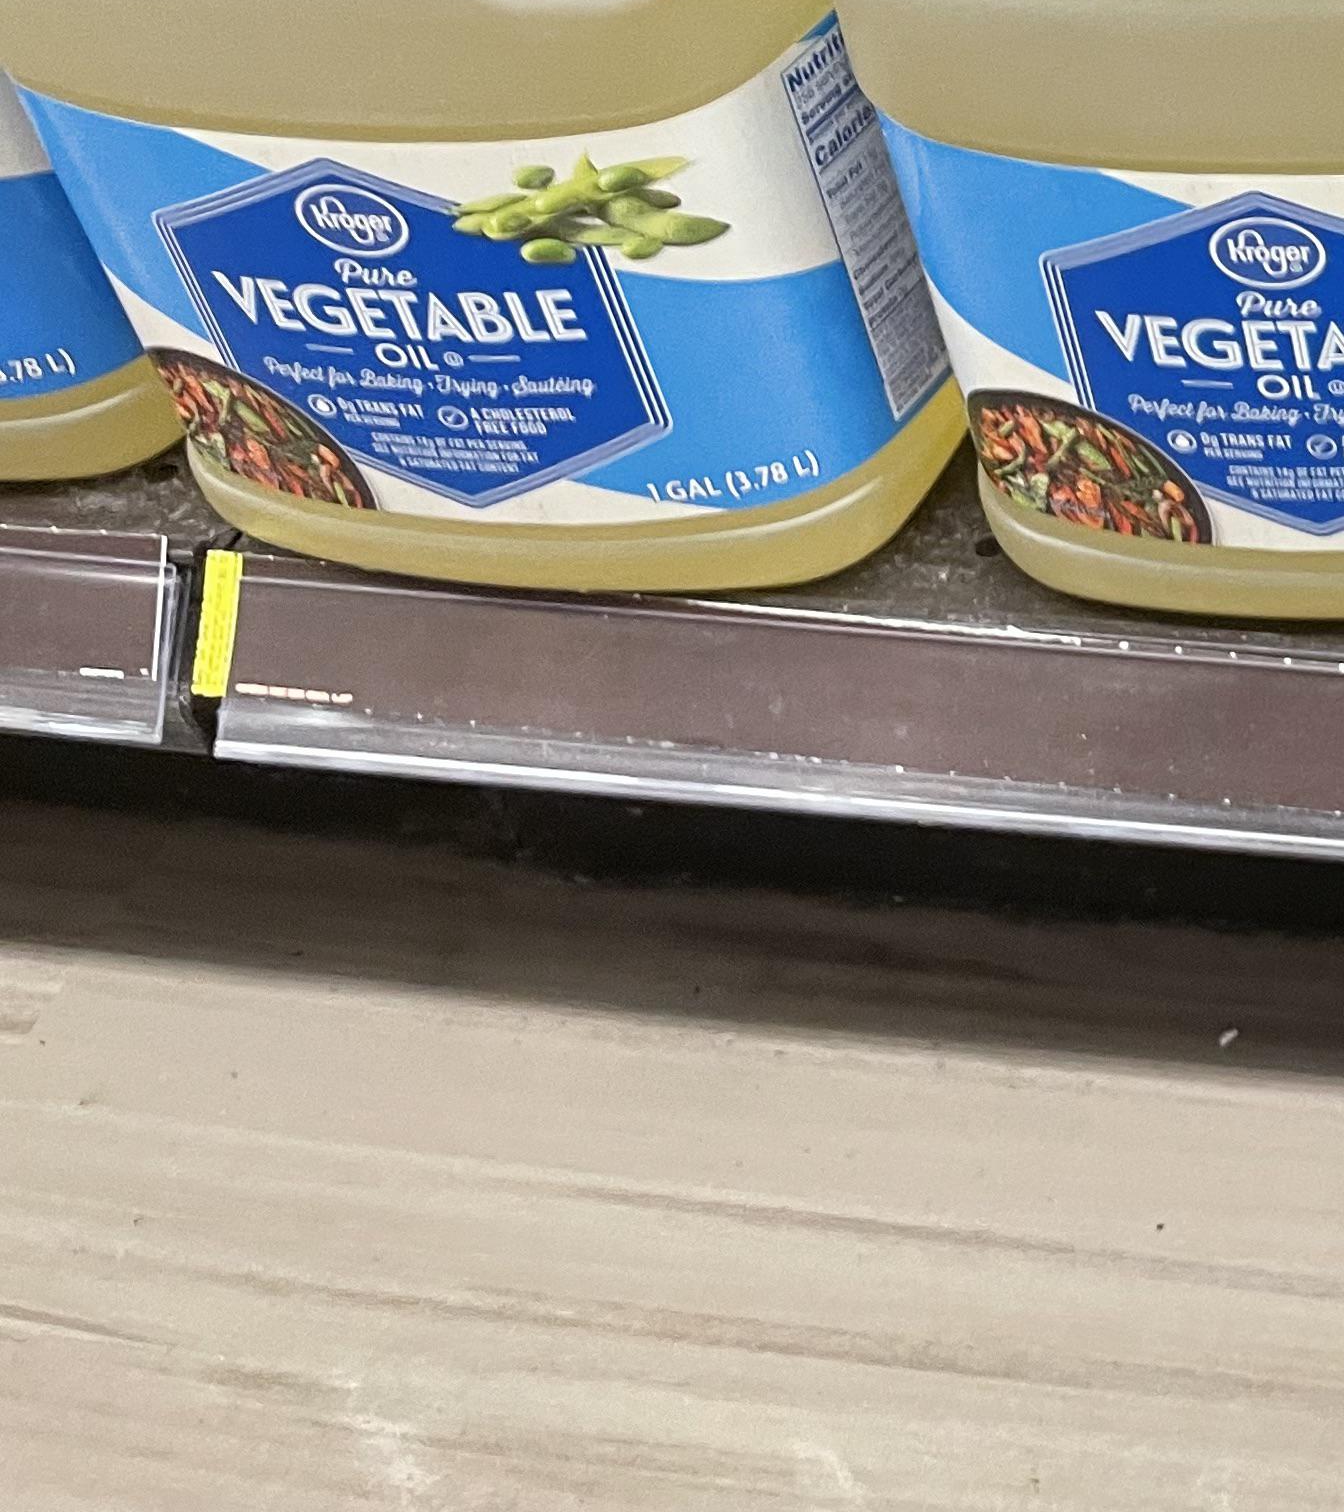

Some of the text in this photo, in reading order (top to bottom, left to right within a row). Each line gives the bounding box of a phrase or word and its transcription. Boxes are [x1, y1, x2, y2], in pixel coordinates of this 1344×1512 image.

[787, 31, 845, 92] Nutriti
[814, 104, 873, 166] Calorie
[311, 195, 392, 245] Kroger
[334, 259, 418, 287] Pure
[1226, 229, 1311, 278] Kroger
[211, 270, 588, 344] VEGETABLE
[1235, 291, 1323, 318] Pure
[374, 343, 439, 371] OIL
[263, 356, 323, 385] Perfect
[328, 366, 355, 389] for
[360, 369, 423, 397] Baking
[434, 374, 503, 400] Frying
[1257, 374, 1321, 400] OIL
[481, 406, 577, 424] CHOLESTEROL
[1127, 393, 1195, 422] Perfect
[1198, 400, 1226, 424] for
[1231, 400, 1301, 428] Baking
[1220, 432, 1265, 450] TRANS
[1267, 434, 1292, 451] FAT
[647, 449, 820, 504] 1 GAL (3.78 L)
